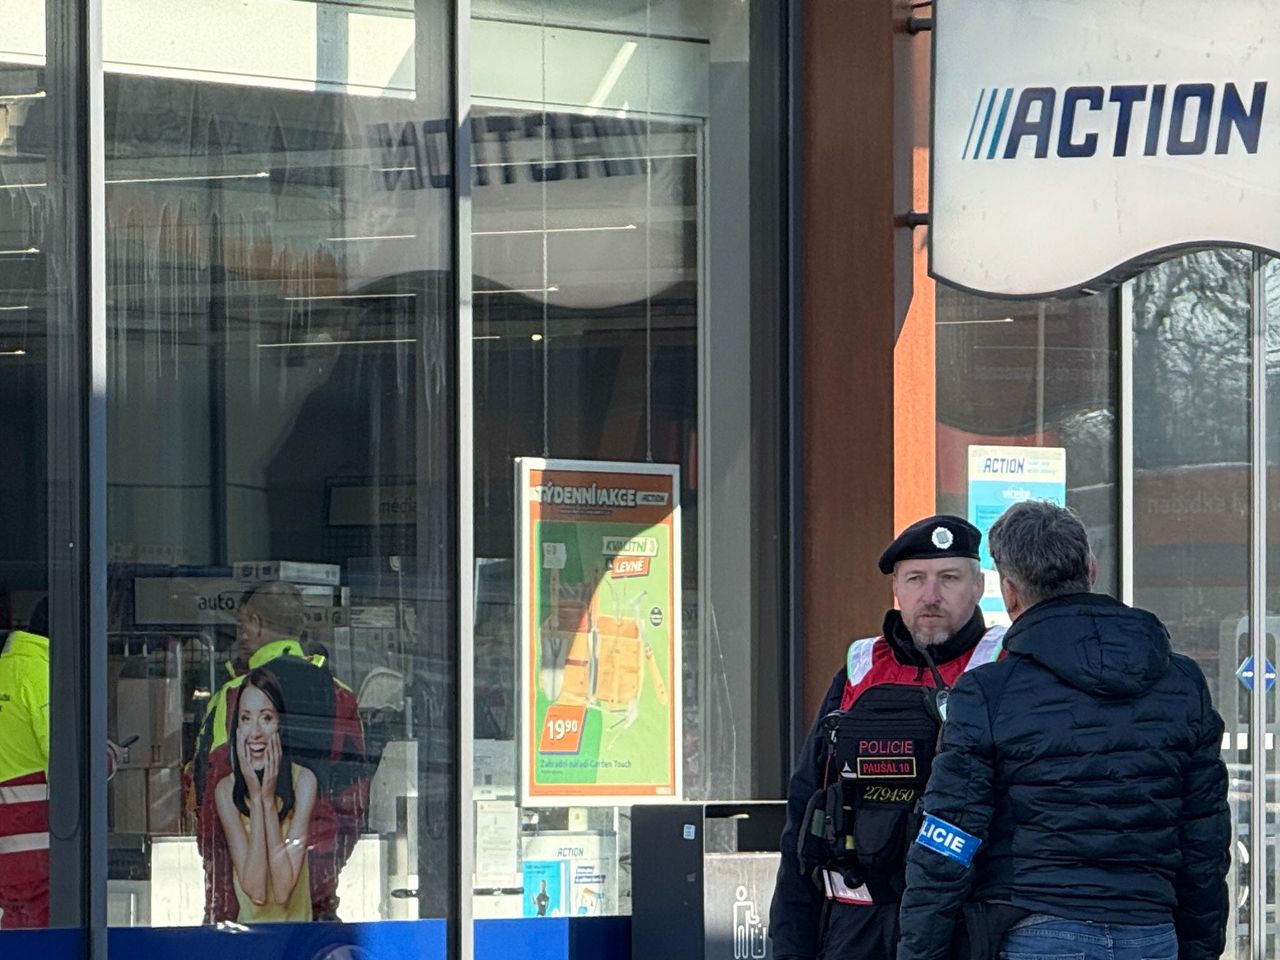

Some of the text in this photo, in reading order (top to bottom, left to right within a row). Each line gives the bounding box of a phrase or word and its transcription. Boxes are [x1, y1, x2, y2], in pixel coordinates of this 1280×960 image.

[1002, 81, 1268, 160] ACTION
[983, 458, 1025, 474] ACTION
[536, 481, 596, 505] TÝDENNÍ
[600, 488, 637, 507] AKCE
[198, 593, 235, 610] auto
[860, 741, 913, 754] POLICIE
[614, 760, 632, 769] Touch
[900, 763, 910, 773] 10
[557, 847, 584, 857] ACTION
